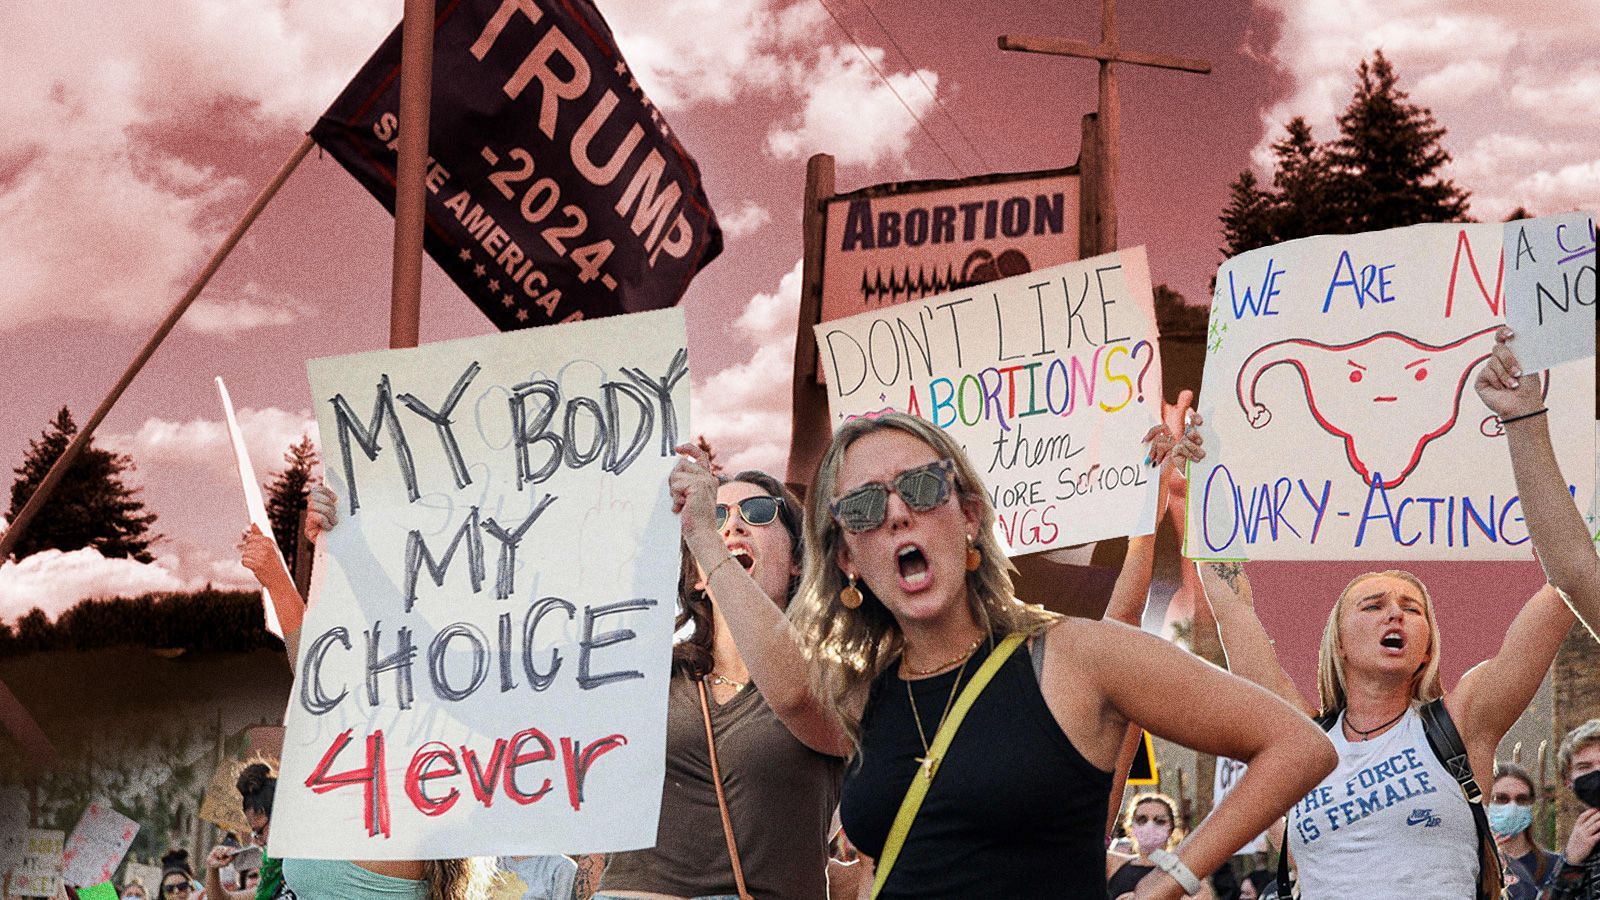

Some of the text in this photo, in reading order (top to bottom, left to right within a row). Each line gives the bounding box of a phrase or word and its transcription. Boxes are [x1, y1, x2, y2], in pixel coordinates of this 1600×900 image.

[469, 0, 693, 267] TRUMP
[373, 112, 562, 317] SE AMERICA
[480, 146, 617, 291] -2024-
[841, 192, 1064, 251] ABORTION
[1515, 226, 1536, 270] A
[1229, 229, 1506, 319] WE ARE N
[826, 264, 1131, 397] DON'T LIKE
[328, 348, 690, 515] MY BODY
[907, 340, 1154, 432] ABORTIONS?
[988, 423, 1086, 473] them
[404, 493, 558, 613] MY
[1203, 464, 1576, 552] OVARY-ACTING
[300, 597, 658, 715] CHOICE
[1296, 771, 1438, 844] IS FEMALE
[1346, 747, 1423, 797] FORCE
